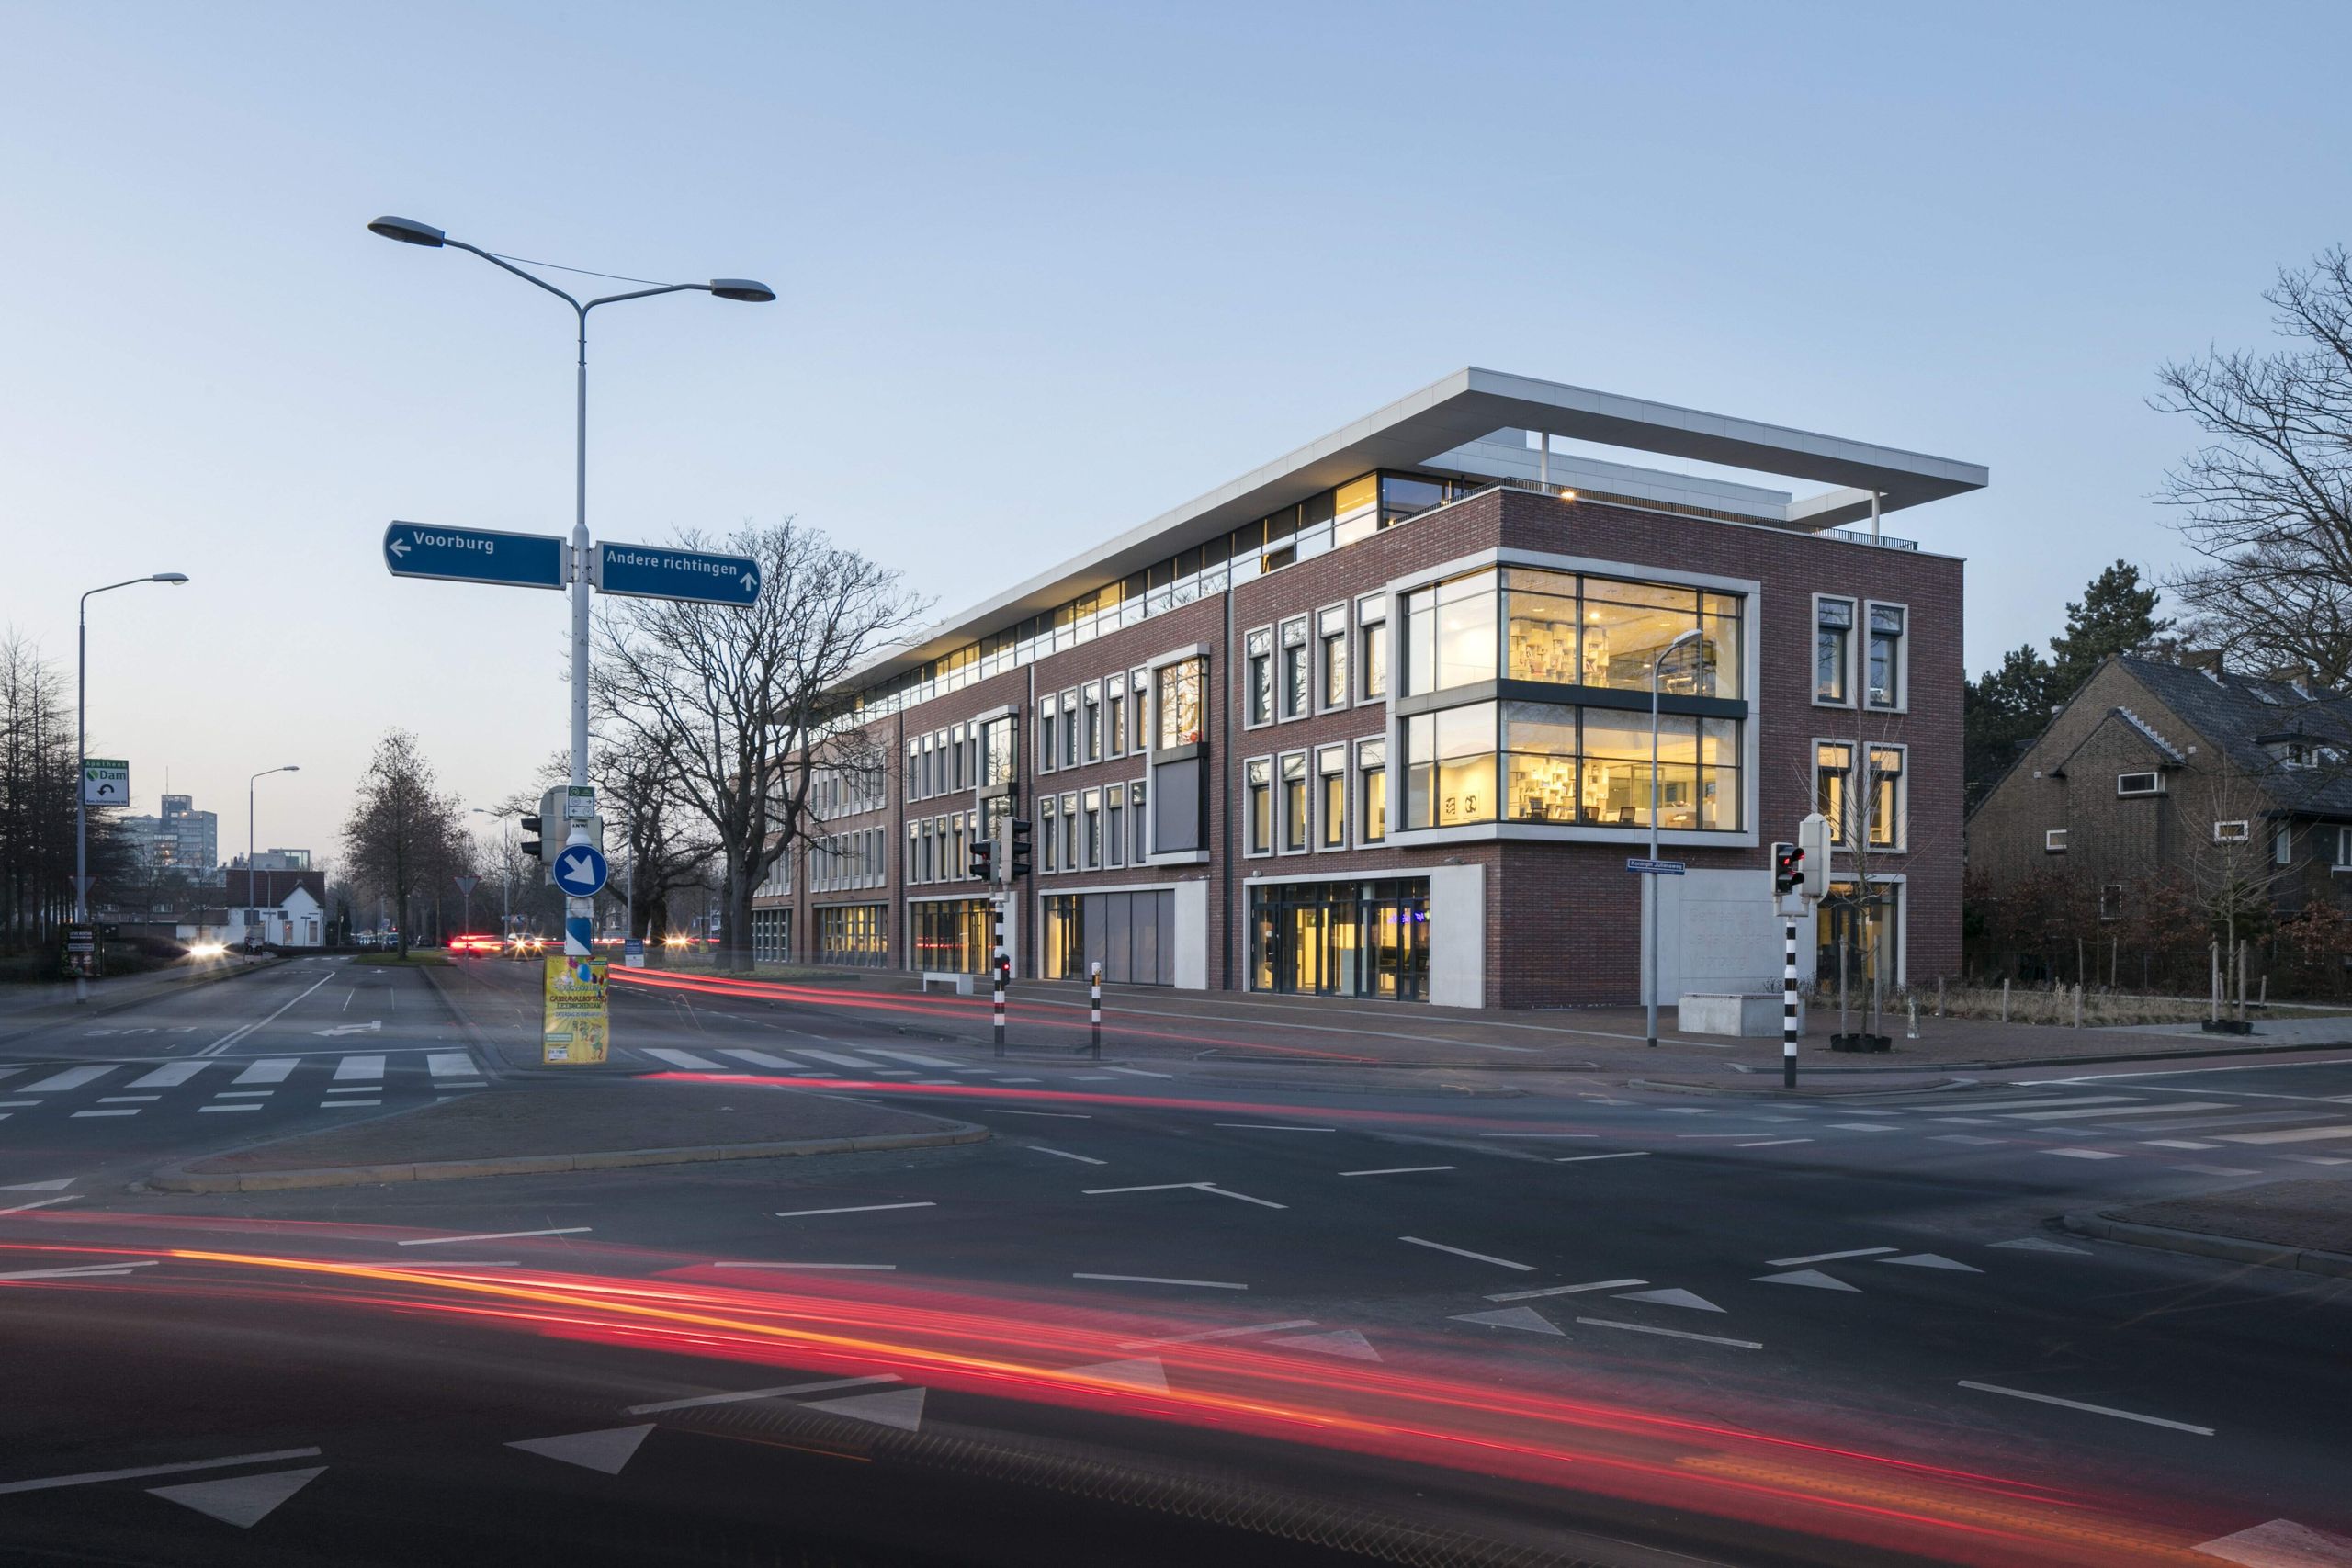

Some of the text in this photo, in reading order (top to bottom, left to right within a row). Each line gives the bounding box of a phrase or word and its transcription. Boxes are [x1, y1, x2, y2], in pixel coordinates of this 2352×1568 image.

[413, 531, 494, 555] Voorburg
[607, 550, 737, 577] Andere richtingen
[100, 771, 126, 780] Dam
[1631, 860, 1653, 868] Koningin
